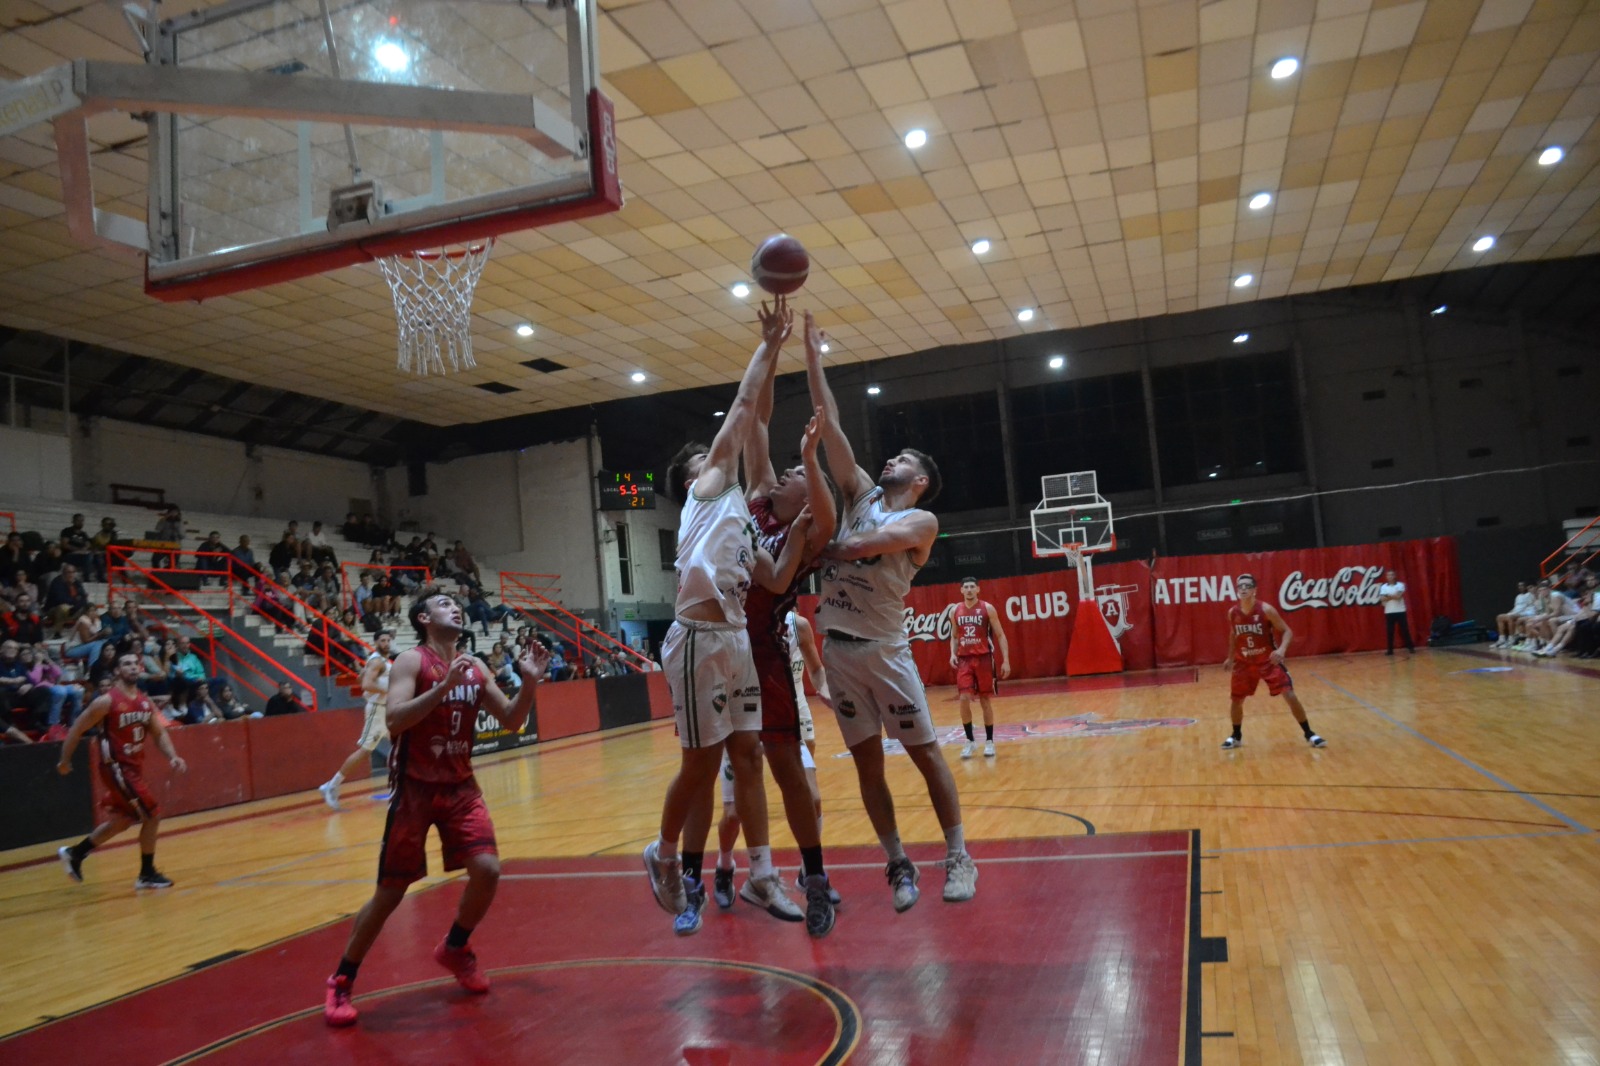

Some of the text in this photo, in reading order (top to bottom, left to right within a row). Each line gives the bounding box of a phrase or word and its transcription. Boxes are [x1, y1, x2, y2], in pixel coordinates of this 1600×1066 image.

[1005, 574, 1238, 622] CLUB ATENA
[1278, 565, 1384, 612] Coca-Cola
[902, 602, 958, 643] oca-C
[963, 625, 976, 638] 32
[451, 710, 462, 736] 9
